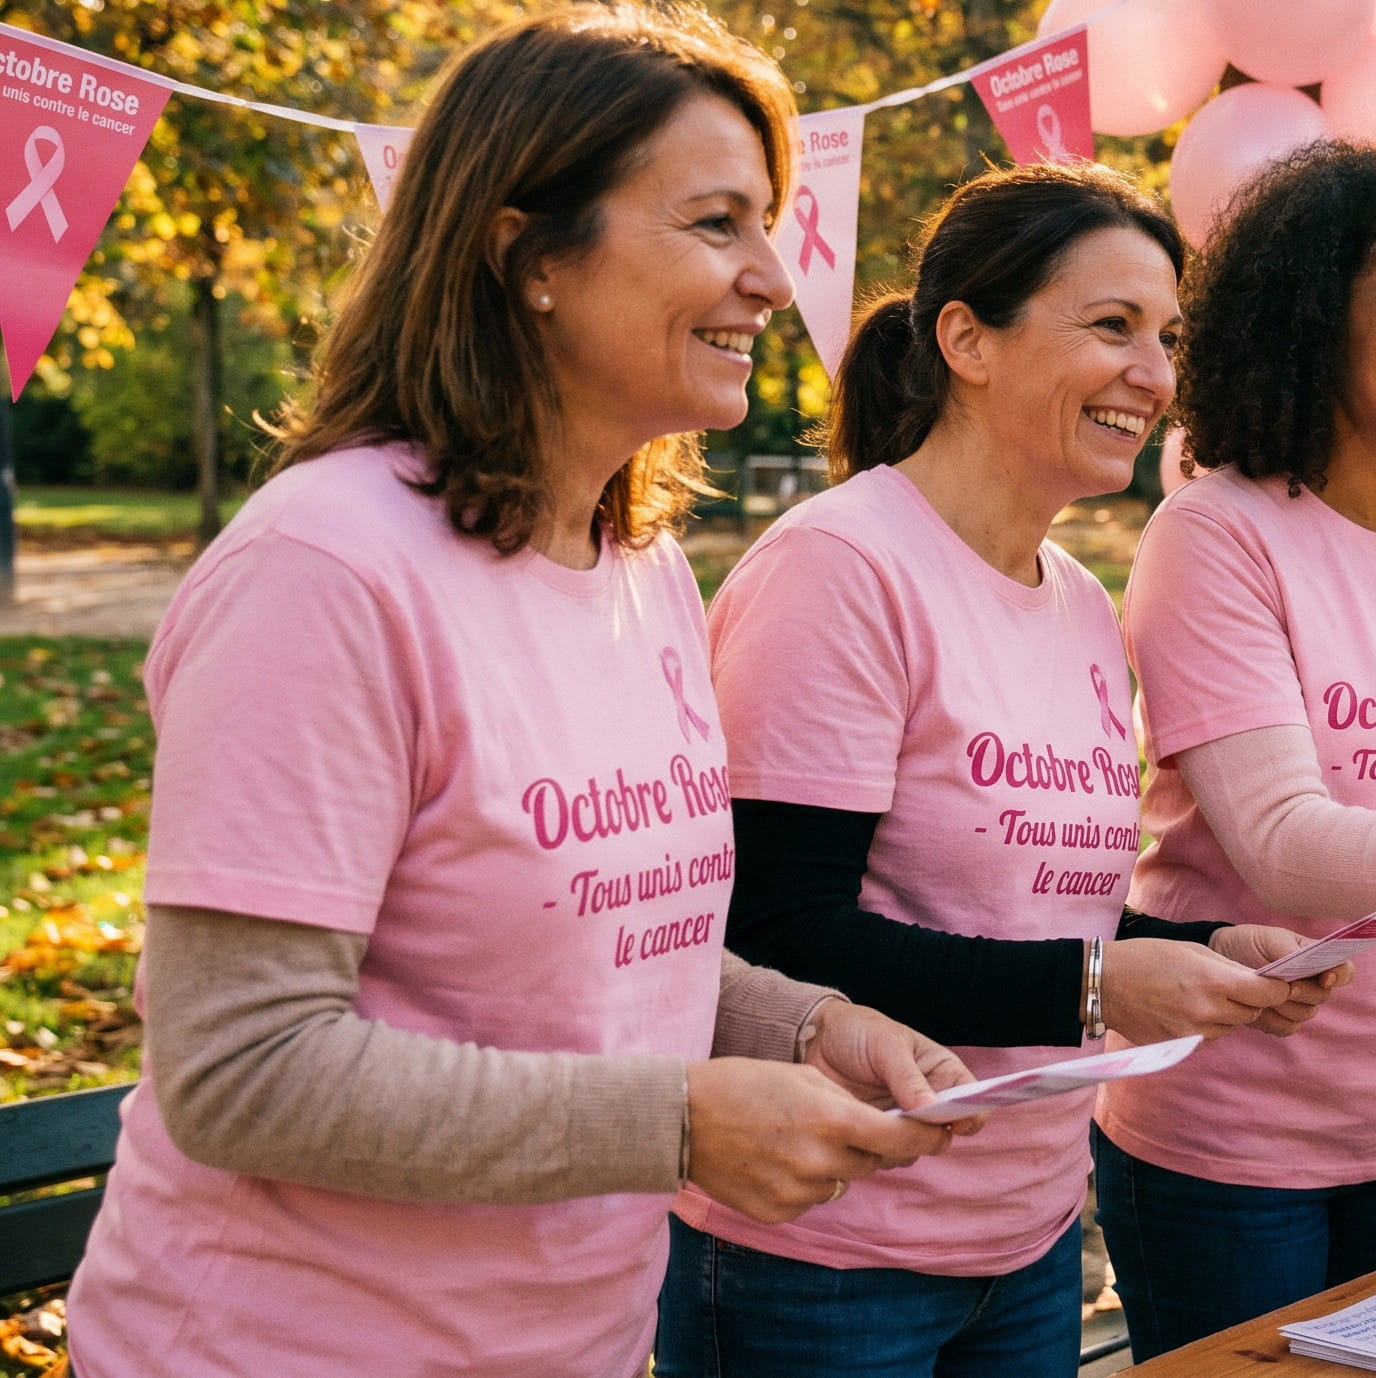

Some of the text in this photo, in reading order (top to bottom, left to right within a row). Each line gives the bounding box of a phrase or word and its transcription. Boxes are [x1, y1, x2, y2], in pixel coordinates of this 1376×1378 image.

[0, 51, 140, 115] tobre Rose
[989, 48, 1080, 98] Octobre Rose
[2, 85, 136, 136] unis contre le cancer
[810, 131, 849, 152] Rose
[966, 731, 1094, 795] Octobre
[521, 768, 673, 850] Octobre
[999, 809, 1056, 846] Tous
[1062, 816, 1100, 849] unis
[570, 869, 632, 917] Tous
[637, 853, 684, 902] unis
[688, 842, 733, 888] contr
[1031, 861, 1121, 896] le cancer
[615, 912, 715, 968] le cancer
